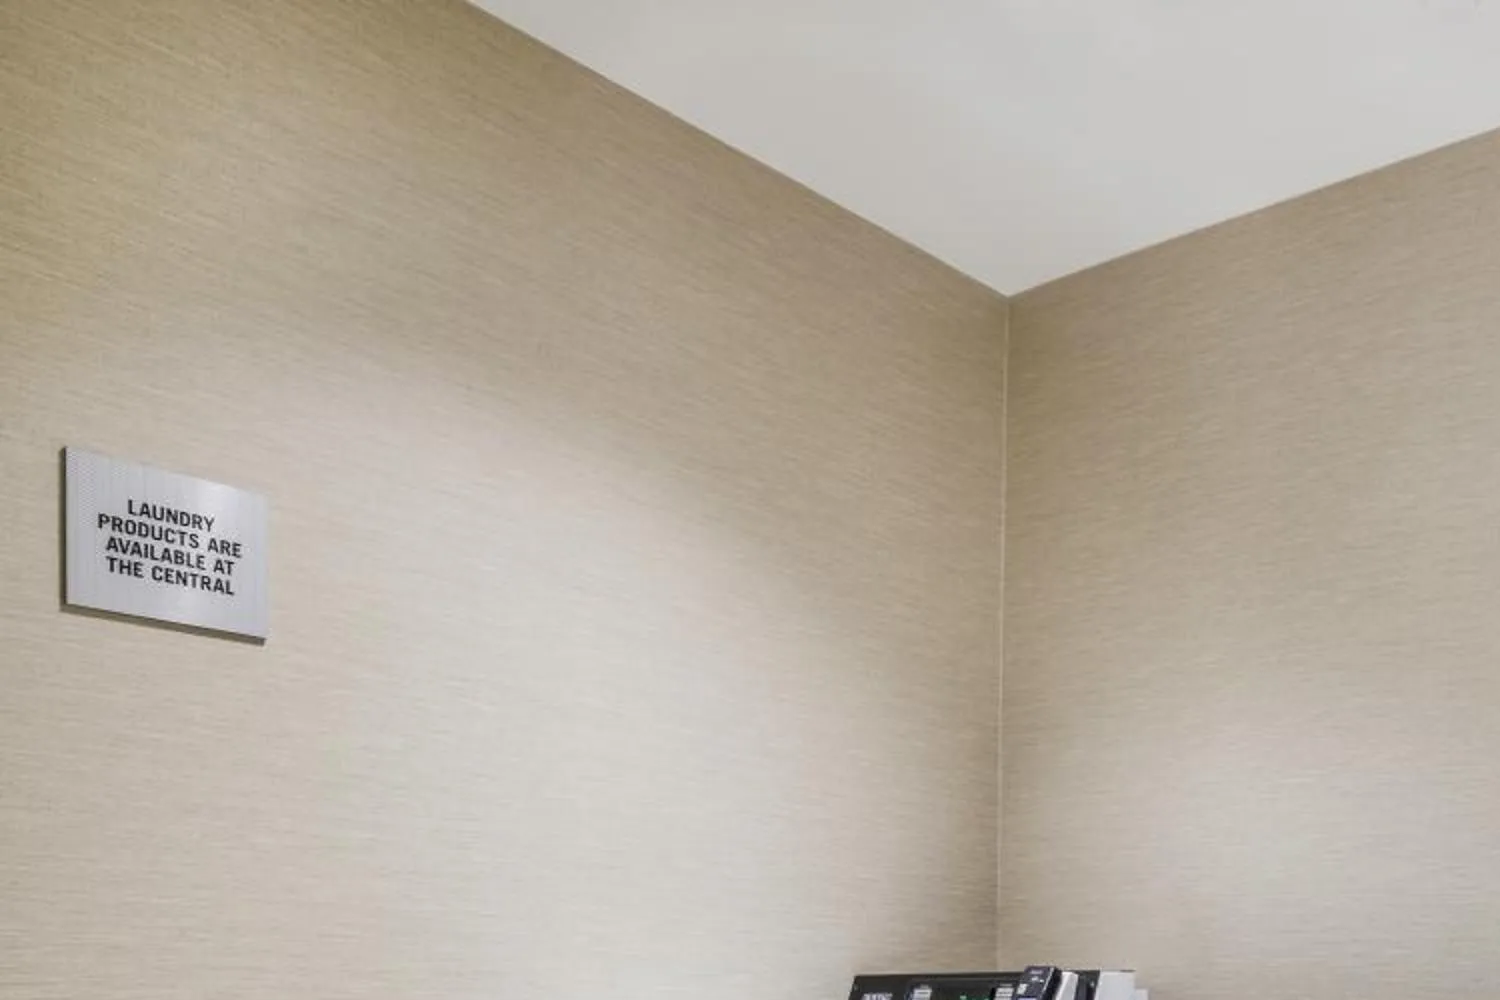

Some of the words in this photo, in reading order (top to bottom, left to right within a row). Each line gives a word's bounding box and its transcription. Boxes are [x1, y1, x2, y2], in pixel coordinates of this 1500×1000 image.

[97, 512, 200, 549] PRODUCTS
[207, 537, 242, 559] ARE
[128, 499, 215, 533] LAUNDRY
[106, 536, 206, 571] AVAILABLE
[213, 559, 235, 576] AT
[106, 556, 144, 579] THE
[151, 565, 235, 596] CENTRAL
